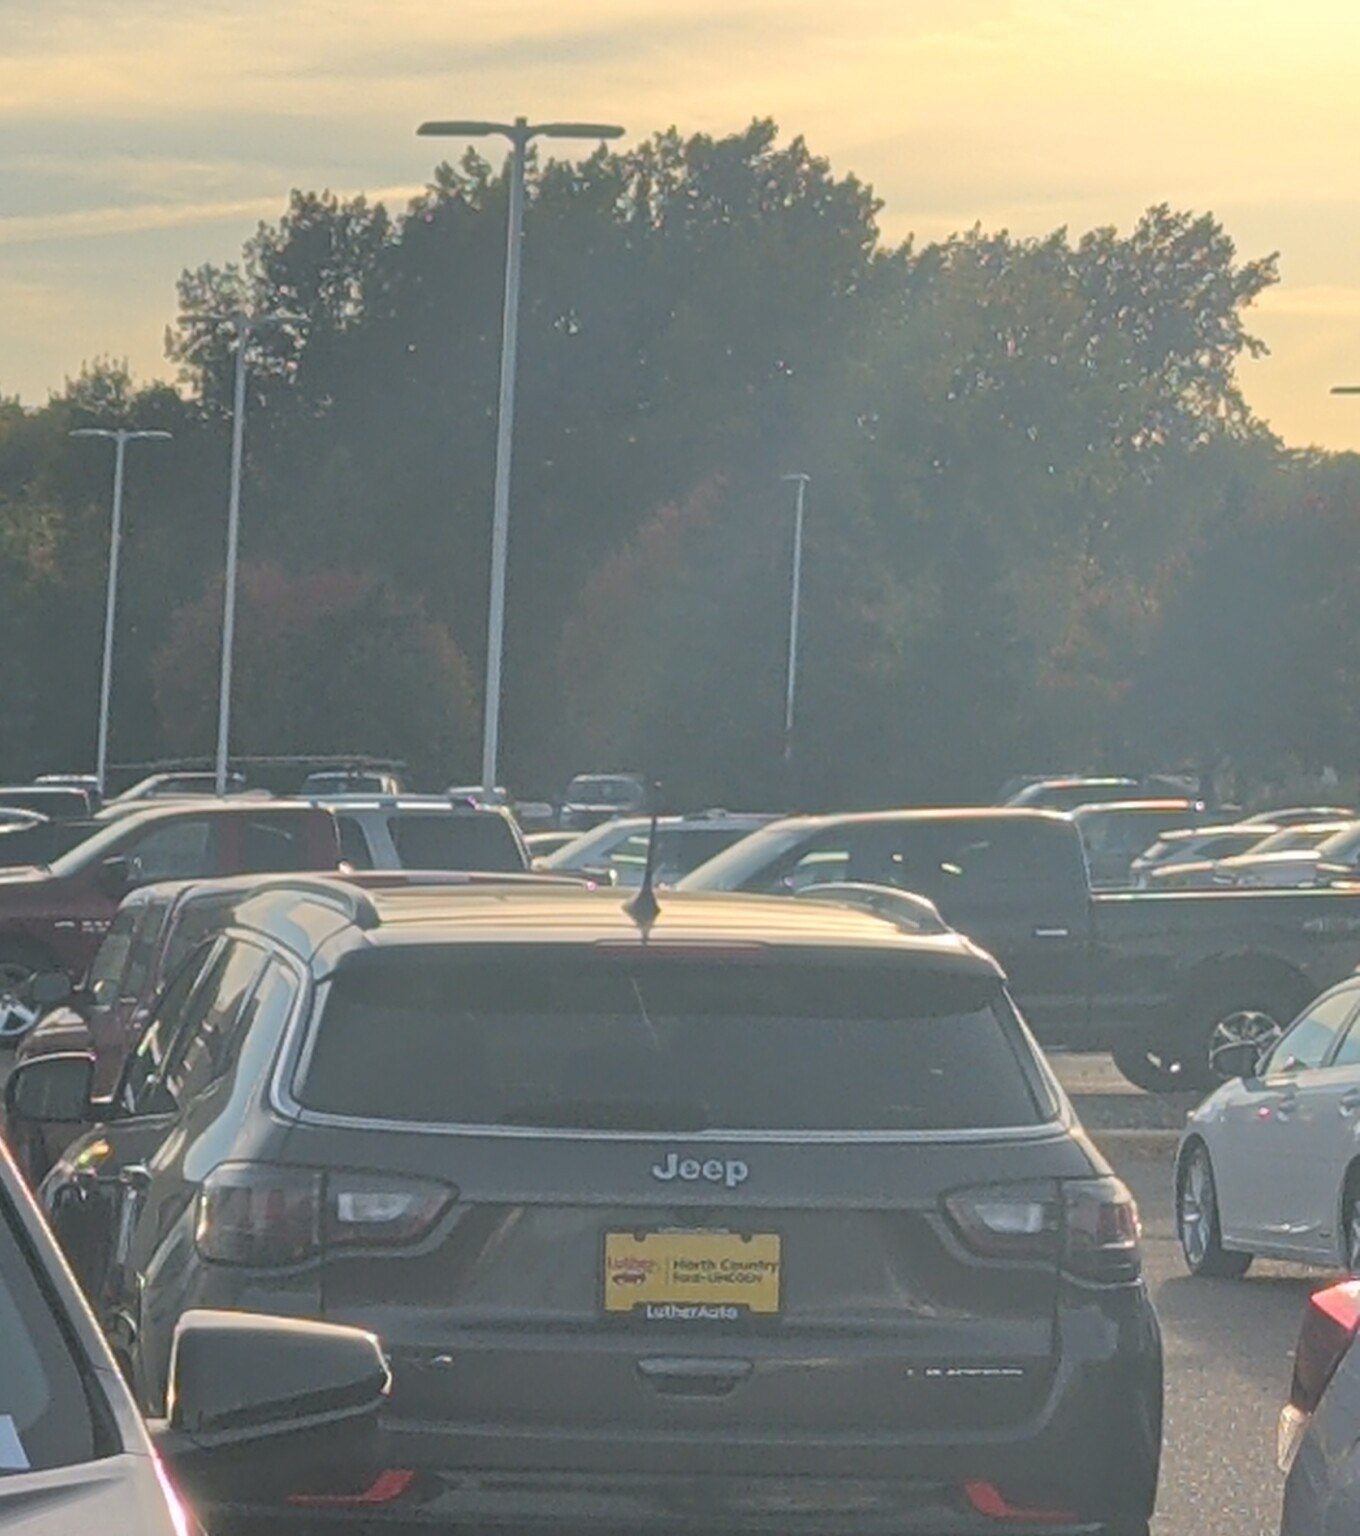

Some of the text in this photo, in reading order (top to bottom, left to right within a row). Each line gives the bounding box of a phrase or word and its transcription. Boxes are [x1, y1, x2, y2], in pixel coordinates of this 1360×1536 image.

[651, 1153, 749, 1187] Jeep
[673, 1258, 777, 1275] North Country
